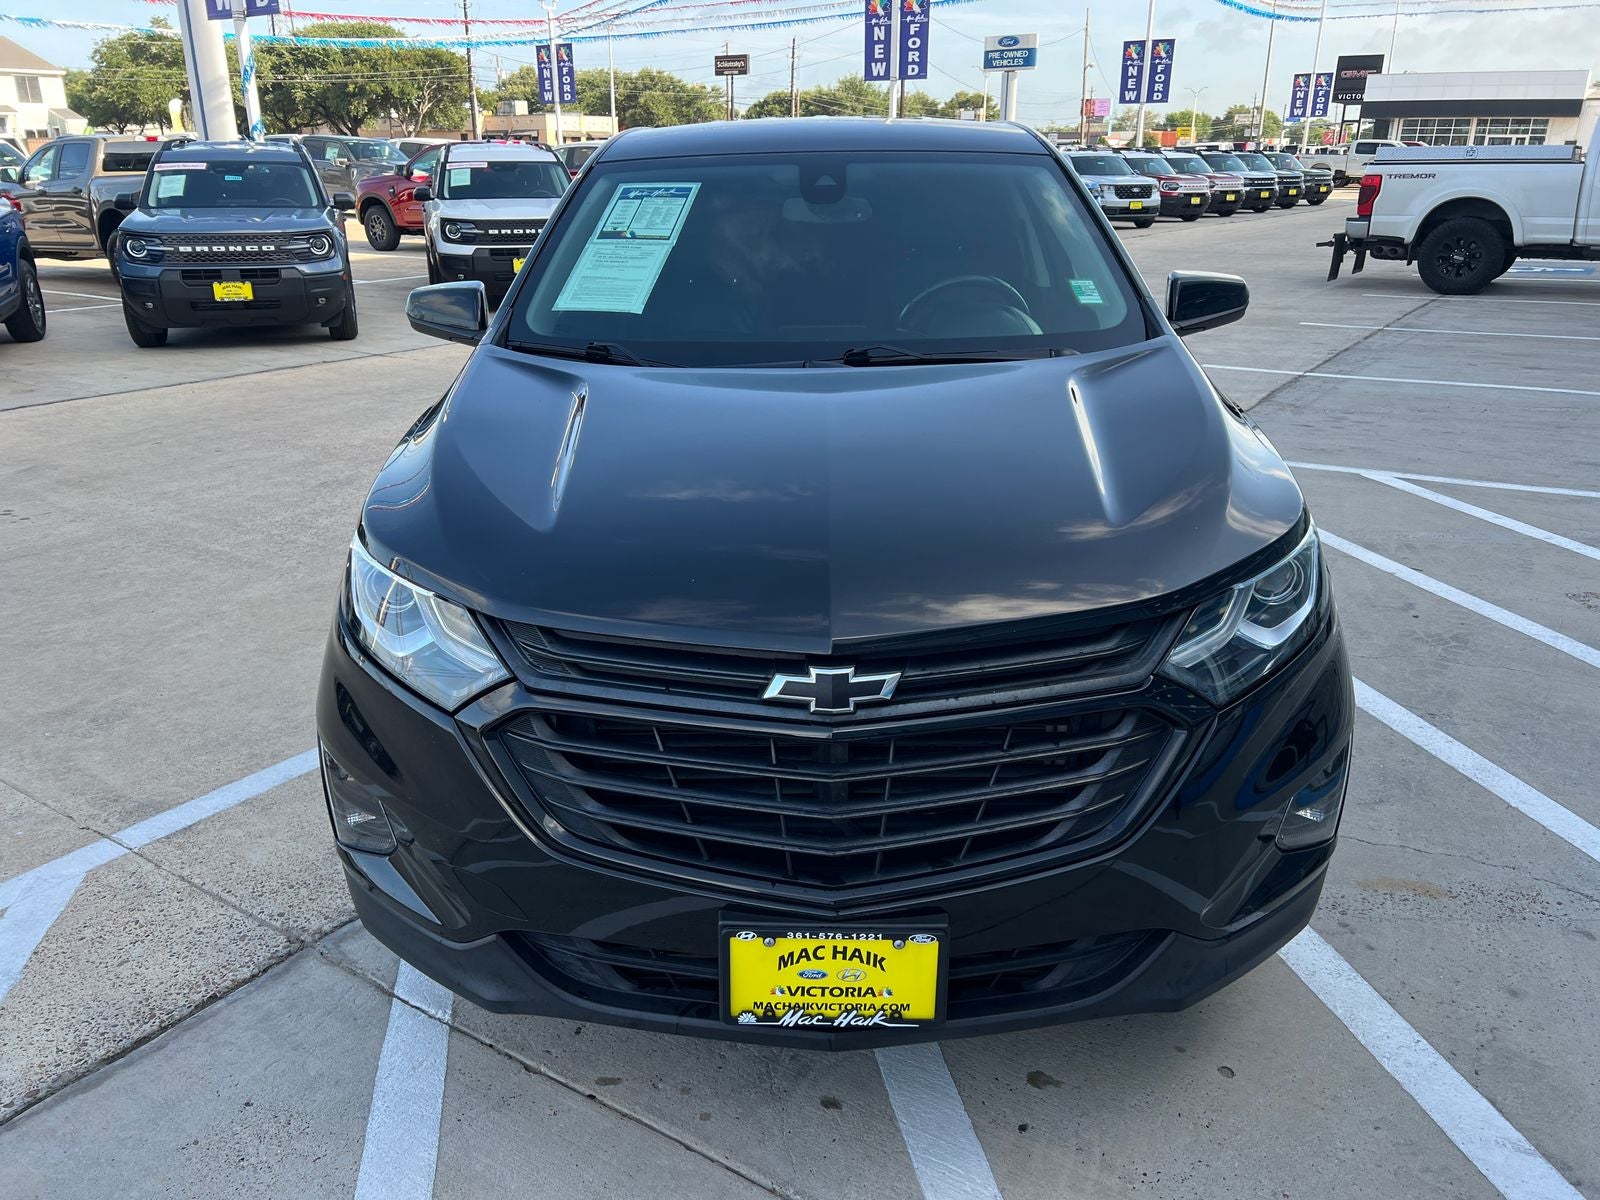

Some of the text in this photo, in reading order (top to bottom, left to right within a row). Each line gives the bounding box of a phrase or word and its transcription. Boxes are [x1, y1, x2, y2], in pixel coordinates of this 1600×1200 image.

[871, 26, 886, 77] NEW
[907, 24, 921, 76] FORD
[988, 50, 1029, 59] PRE-OWNED
[992, 58, 1024, 67] VEHICLES
[543, 69, 553, 102] NEW
[562, 67, 572, 101] FORD
[1125, 65, 1138, 101] NEW
[1153, 64, 1166, 101] FORD
[1293, 91, 1304, 116] NEW
[1315, 90, 1326, 116] FORD
[786, 931, 883, 941] 361-576-1221
[777, 945, 887, 973] MAC HAIK
[786, 986, 877, 998] VICTORIA
[752, 1001, 911, 1012] MACHAIKVICTORIACOM
[778, 1009, 888, 1027] Mac Haik
